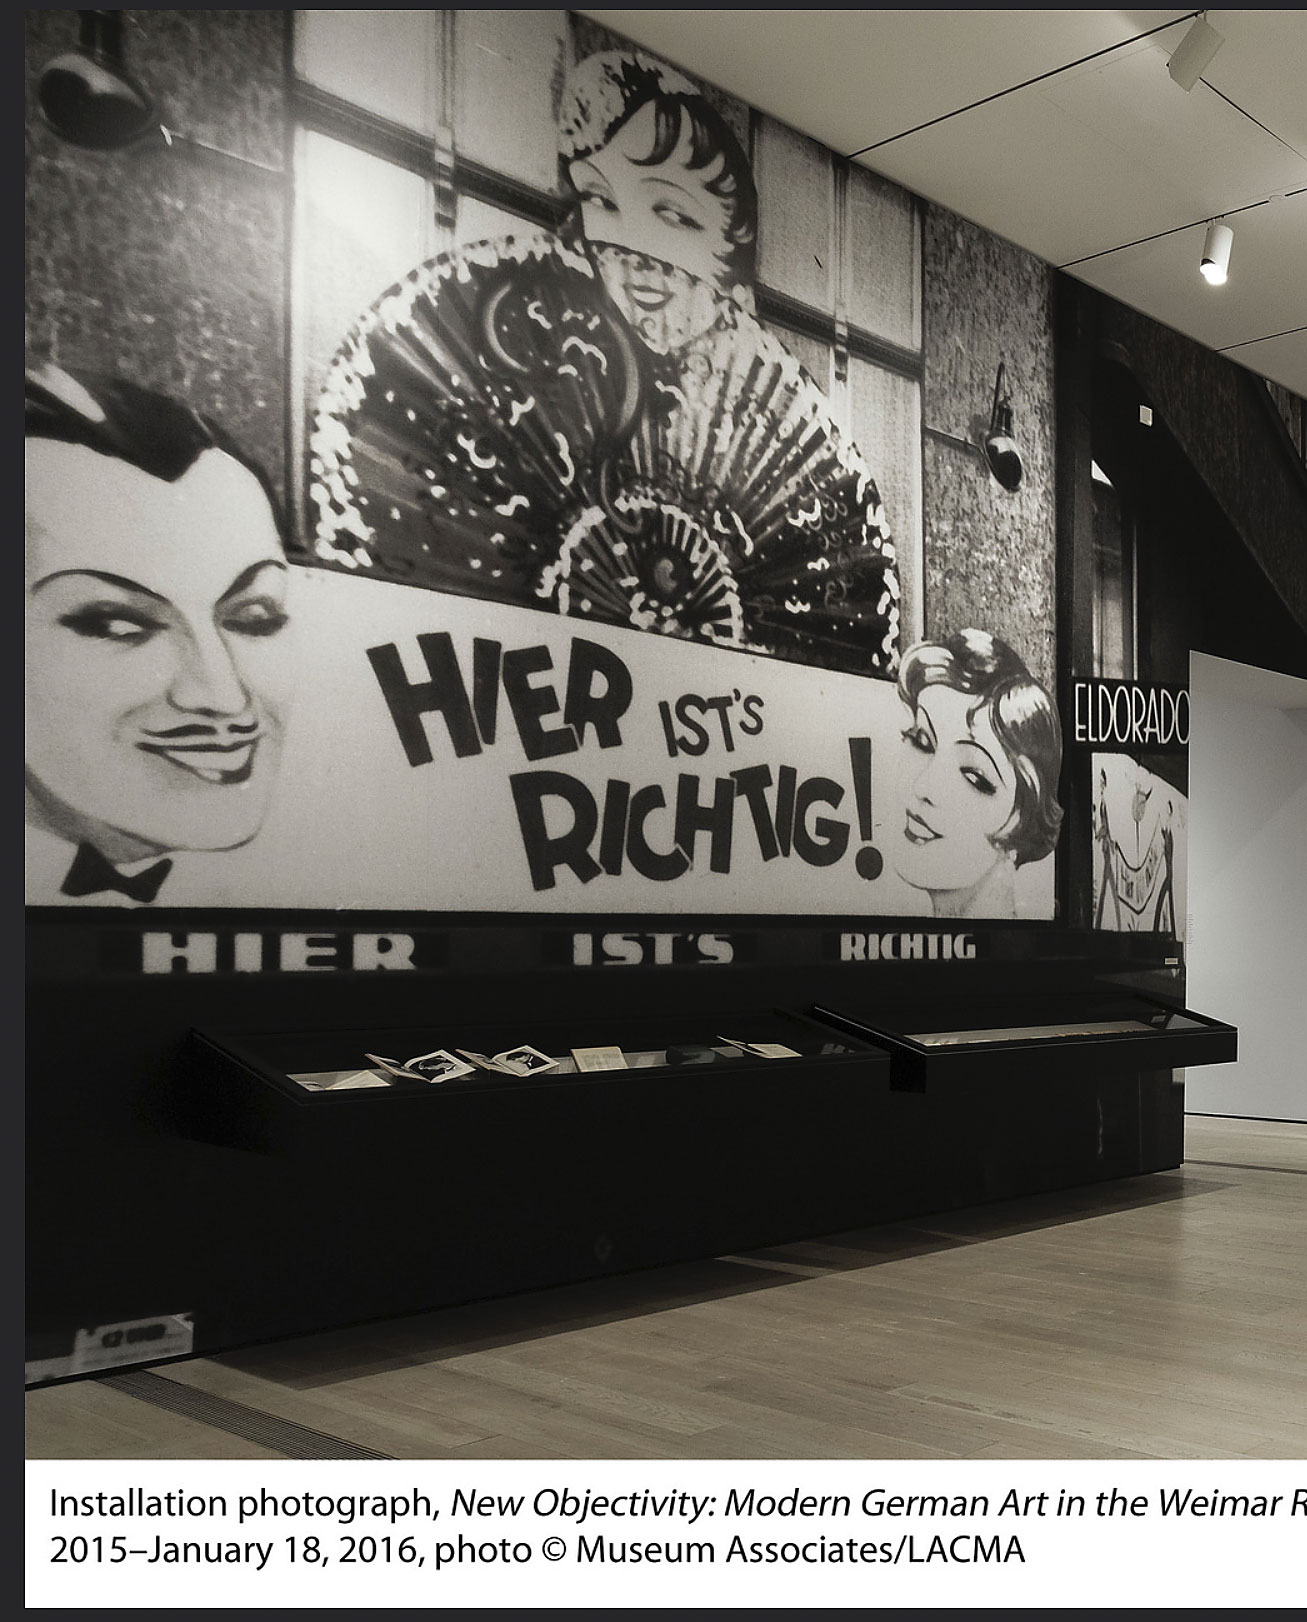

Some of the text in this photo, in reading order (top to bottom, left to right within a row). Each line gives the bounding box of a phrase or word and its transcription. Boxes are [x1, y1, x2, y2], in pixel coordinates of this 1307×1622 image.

[366, 631, 765, 768] HIER IST'S
[1075, 683, 1190, 745] ELDORADO
[509, 737, 884, 893] RICHTIG!
[142, 932, 976, 974] HIER IST'S RICHTIG
